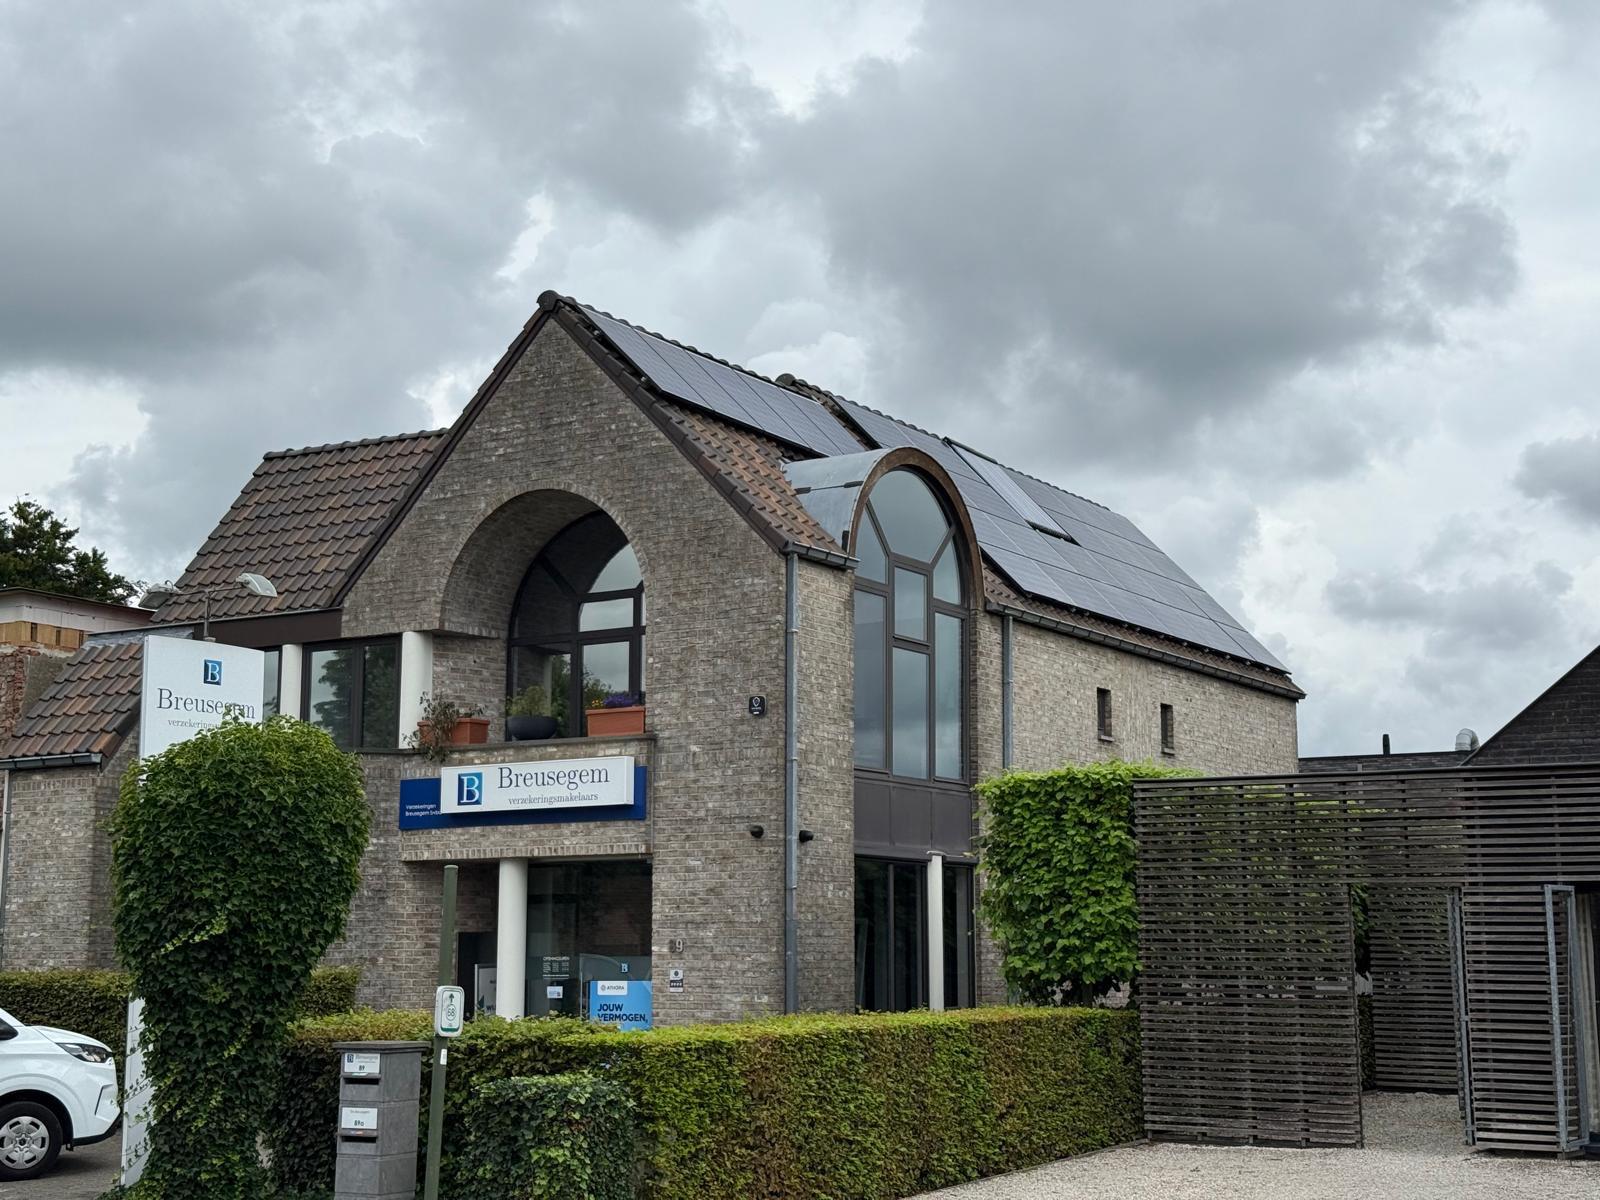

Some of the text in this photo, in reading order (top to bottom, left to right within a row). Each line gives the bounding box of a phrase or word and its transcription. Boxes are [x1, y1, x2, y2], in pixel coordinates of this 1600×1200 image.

[206, 662, 220, 682] B
[157, 688, 256, 719] Breusem
[498, 766, 610, 790] Breusegem
[460, 775, 480, 804] B
[508, 792, 599, 805] verzekeringsmakelaars
[621, 963, 629, 973] B
[597, 1003, 624, 1012] JOUW
[597, 1013, 648, 1024] VERMOGEN,
